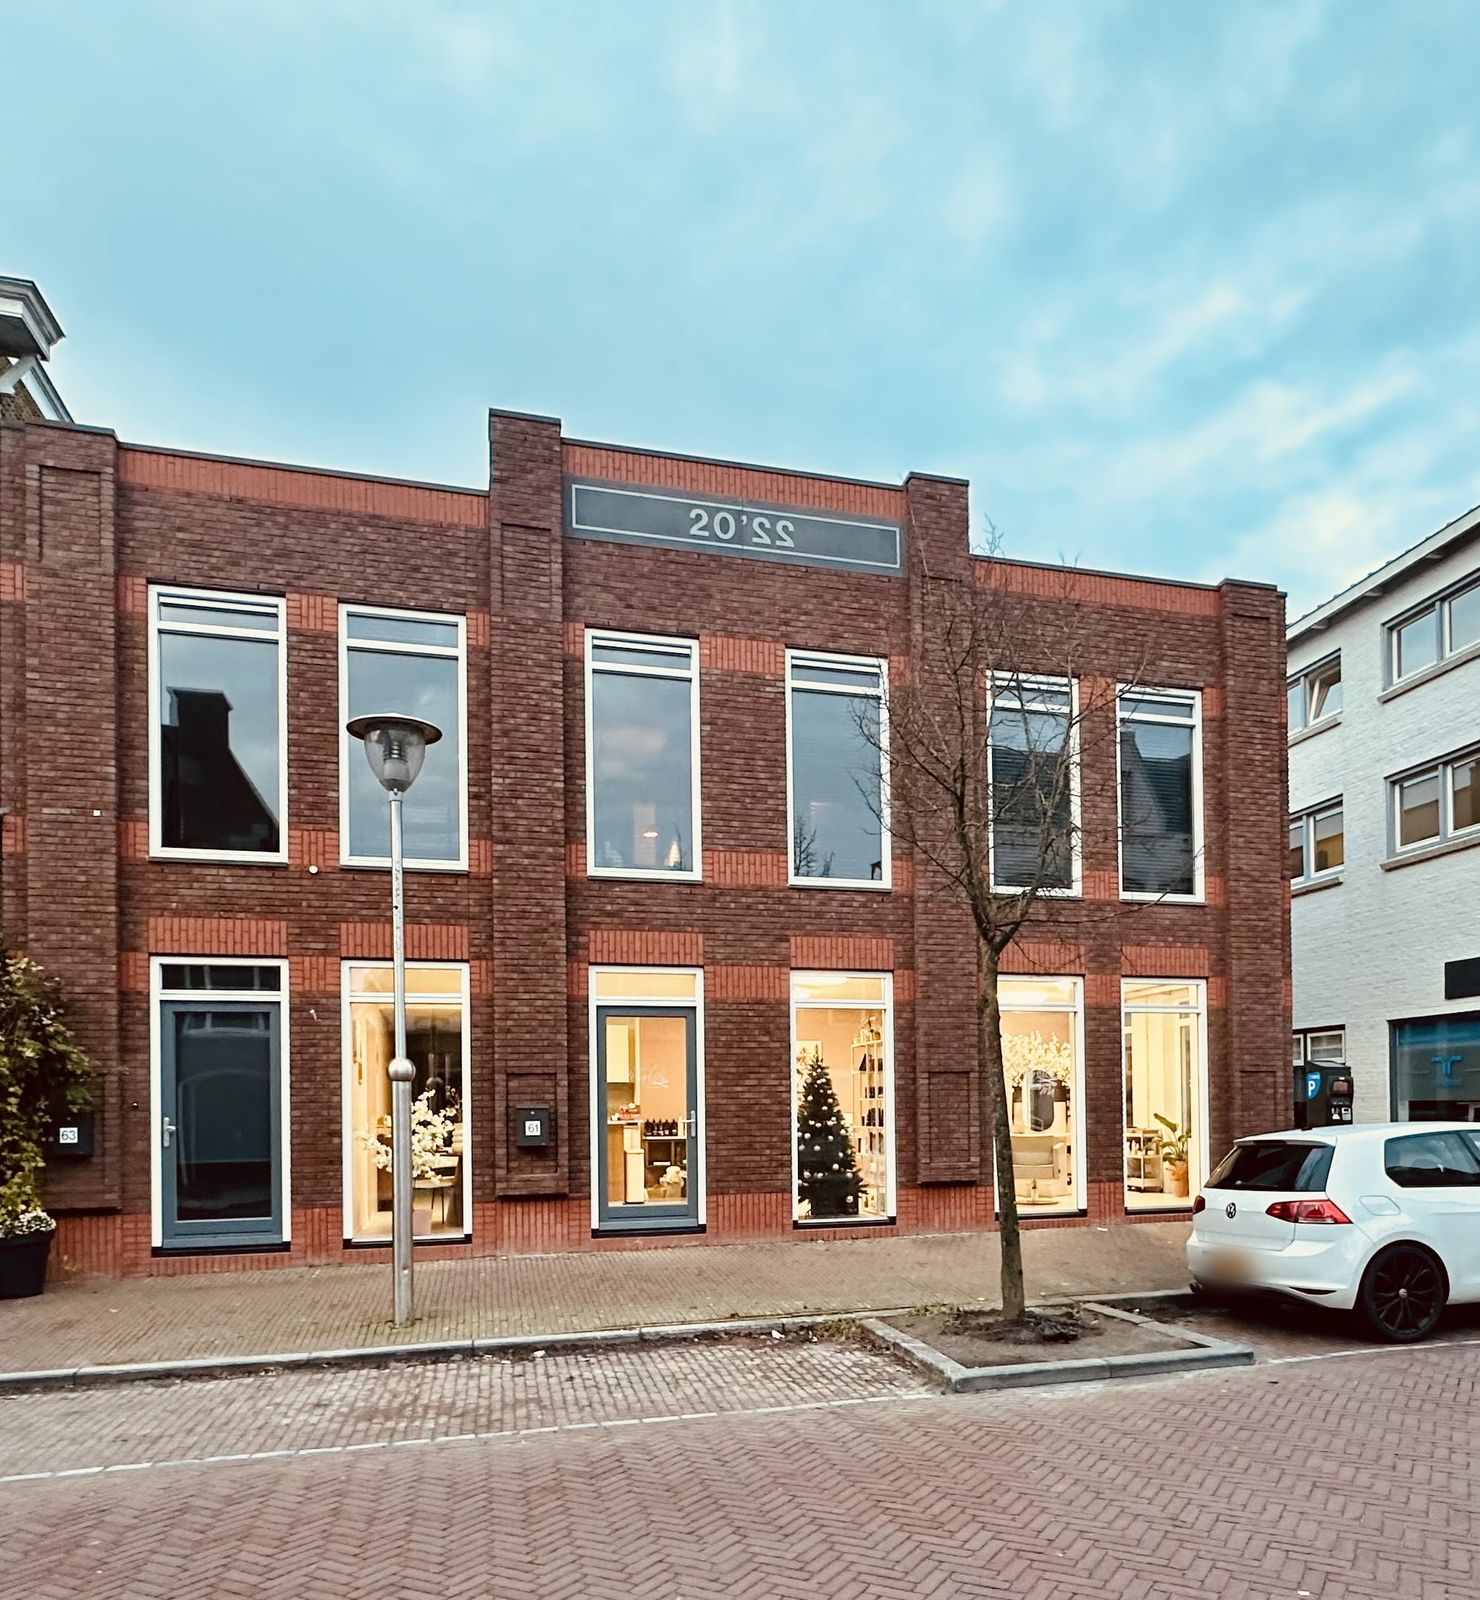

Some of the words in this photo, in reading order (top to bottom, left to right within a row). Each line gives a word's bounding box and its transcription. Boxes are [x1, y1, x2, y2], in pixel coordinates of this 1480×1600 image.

[1307, 1080, 1316, 1096] P
[528, 1123, 539, 1133] 61
[61, 1130, 76, 1141] 63
